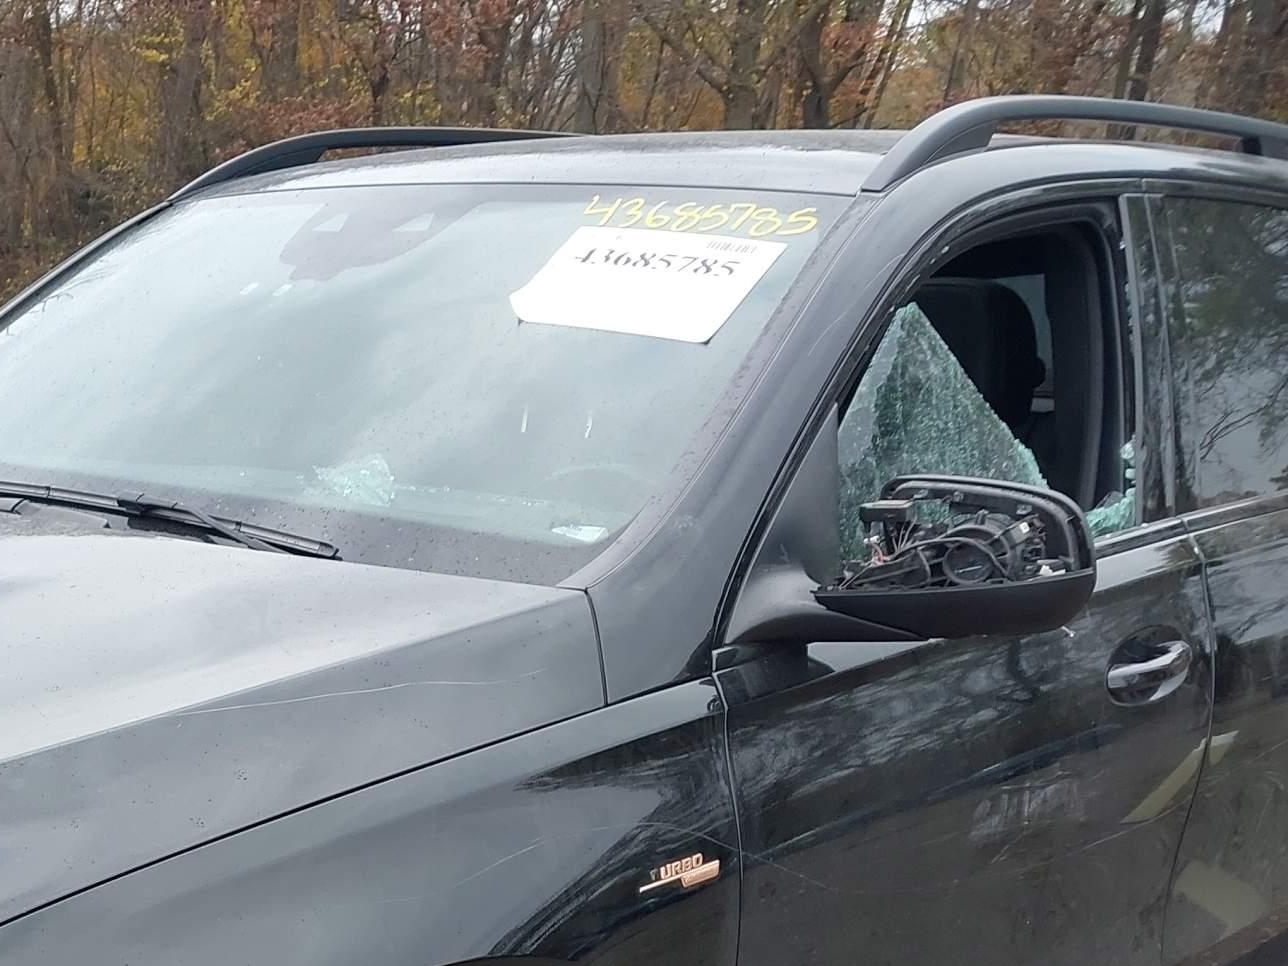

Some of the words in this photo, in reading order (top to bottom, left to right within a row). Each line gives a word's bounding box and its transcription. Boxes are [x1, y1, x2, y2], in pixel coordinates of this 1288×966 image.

[584, 194, 818, 237] 43685785
[575, 248, 741, 277] 43685785
[651, 853, 703, 880] TURBO
